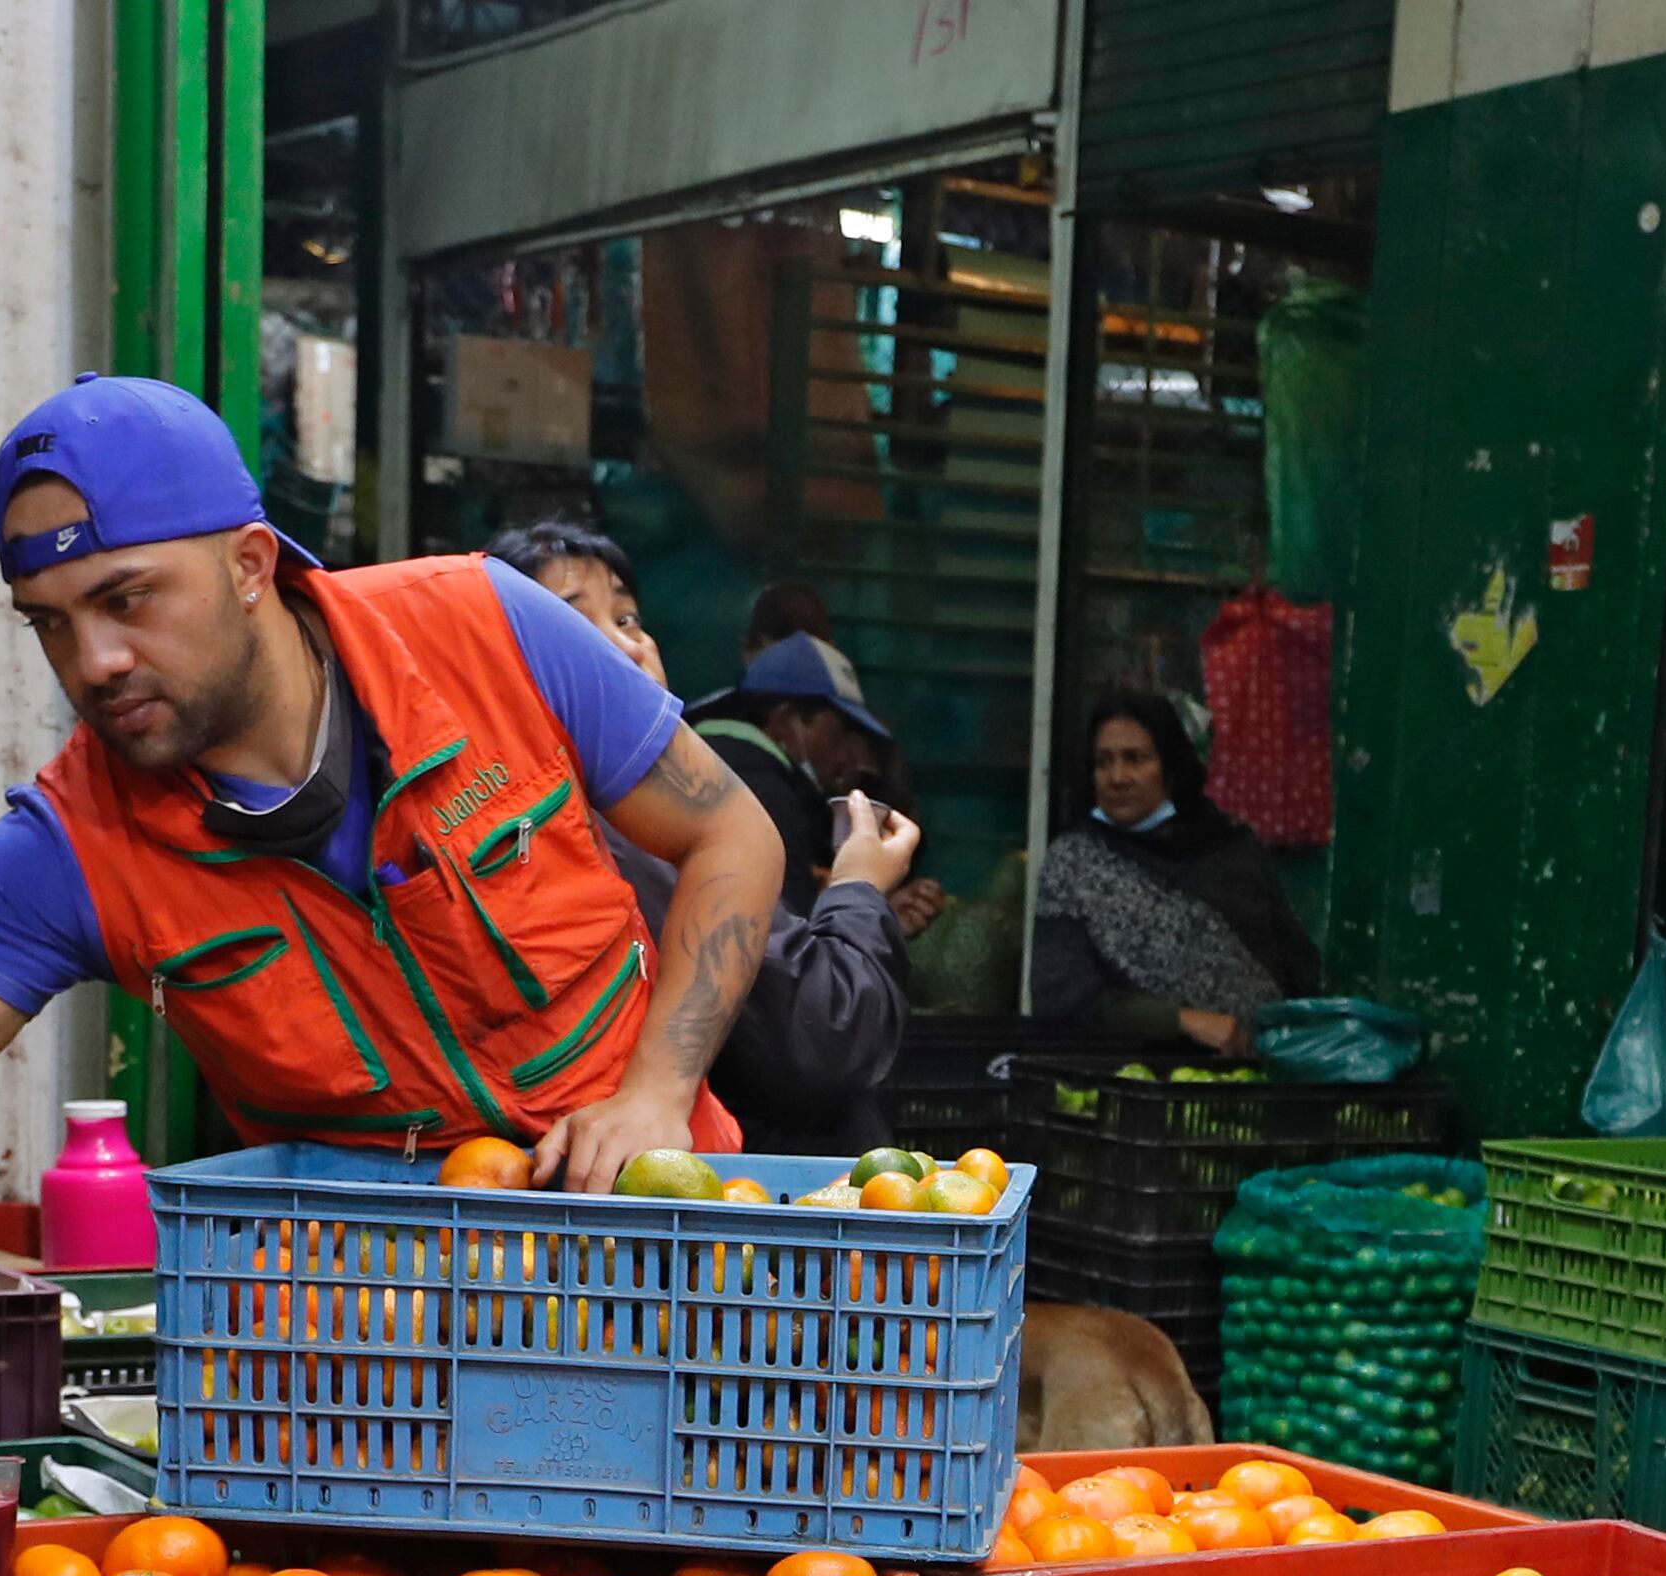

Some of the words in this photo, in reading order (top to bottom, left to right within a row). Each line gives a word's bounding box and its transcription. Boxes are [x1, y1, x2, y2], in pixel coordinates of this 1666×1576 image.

[16, 431, 58, 461] NIKE
[430, 762, 510, 836] Juancho
[511, 1372, 618, 1403] UVAS
